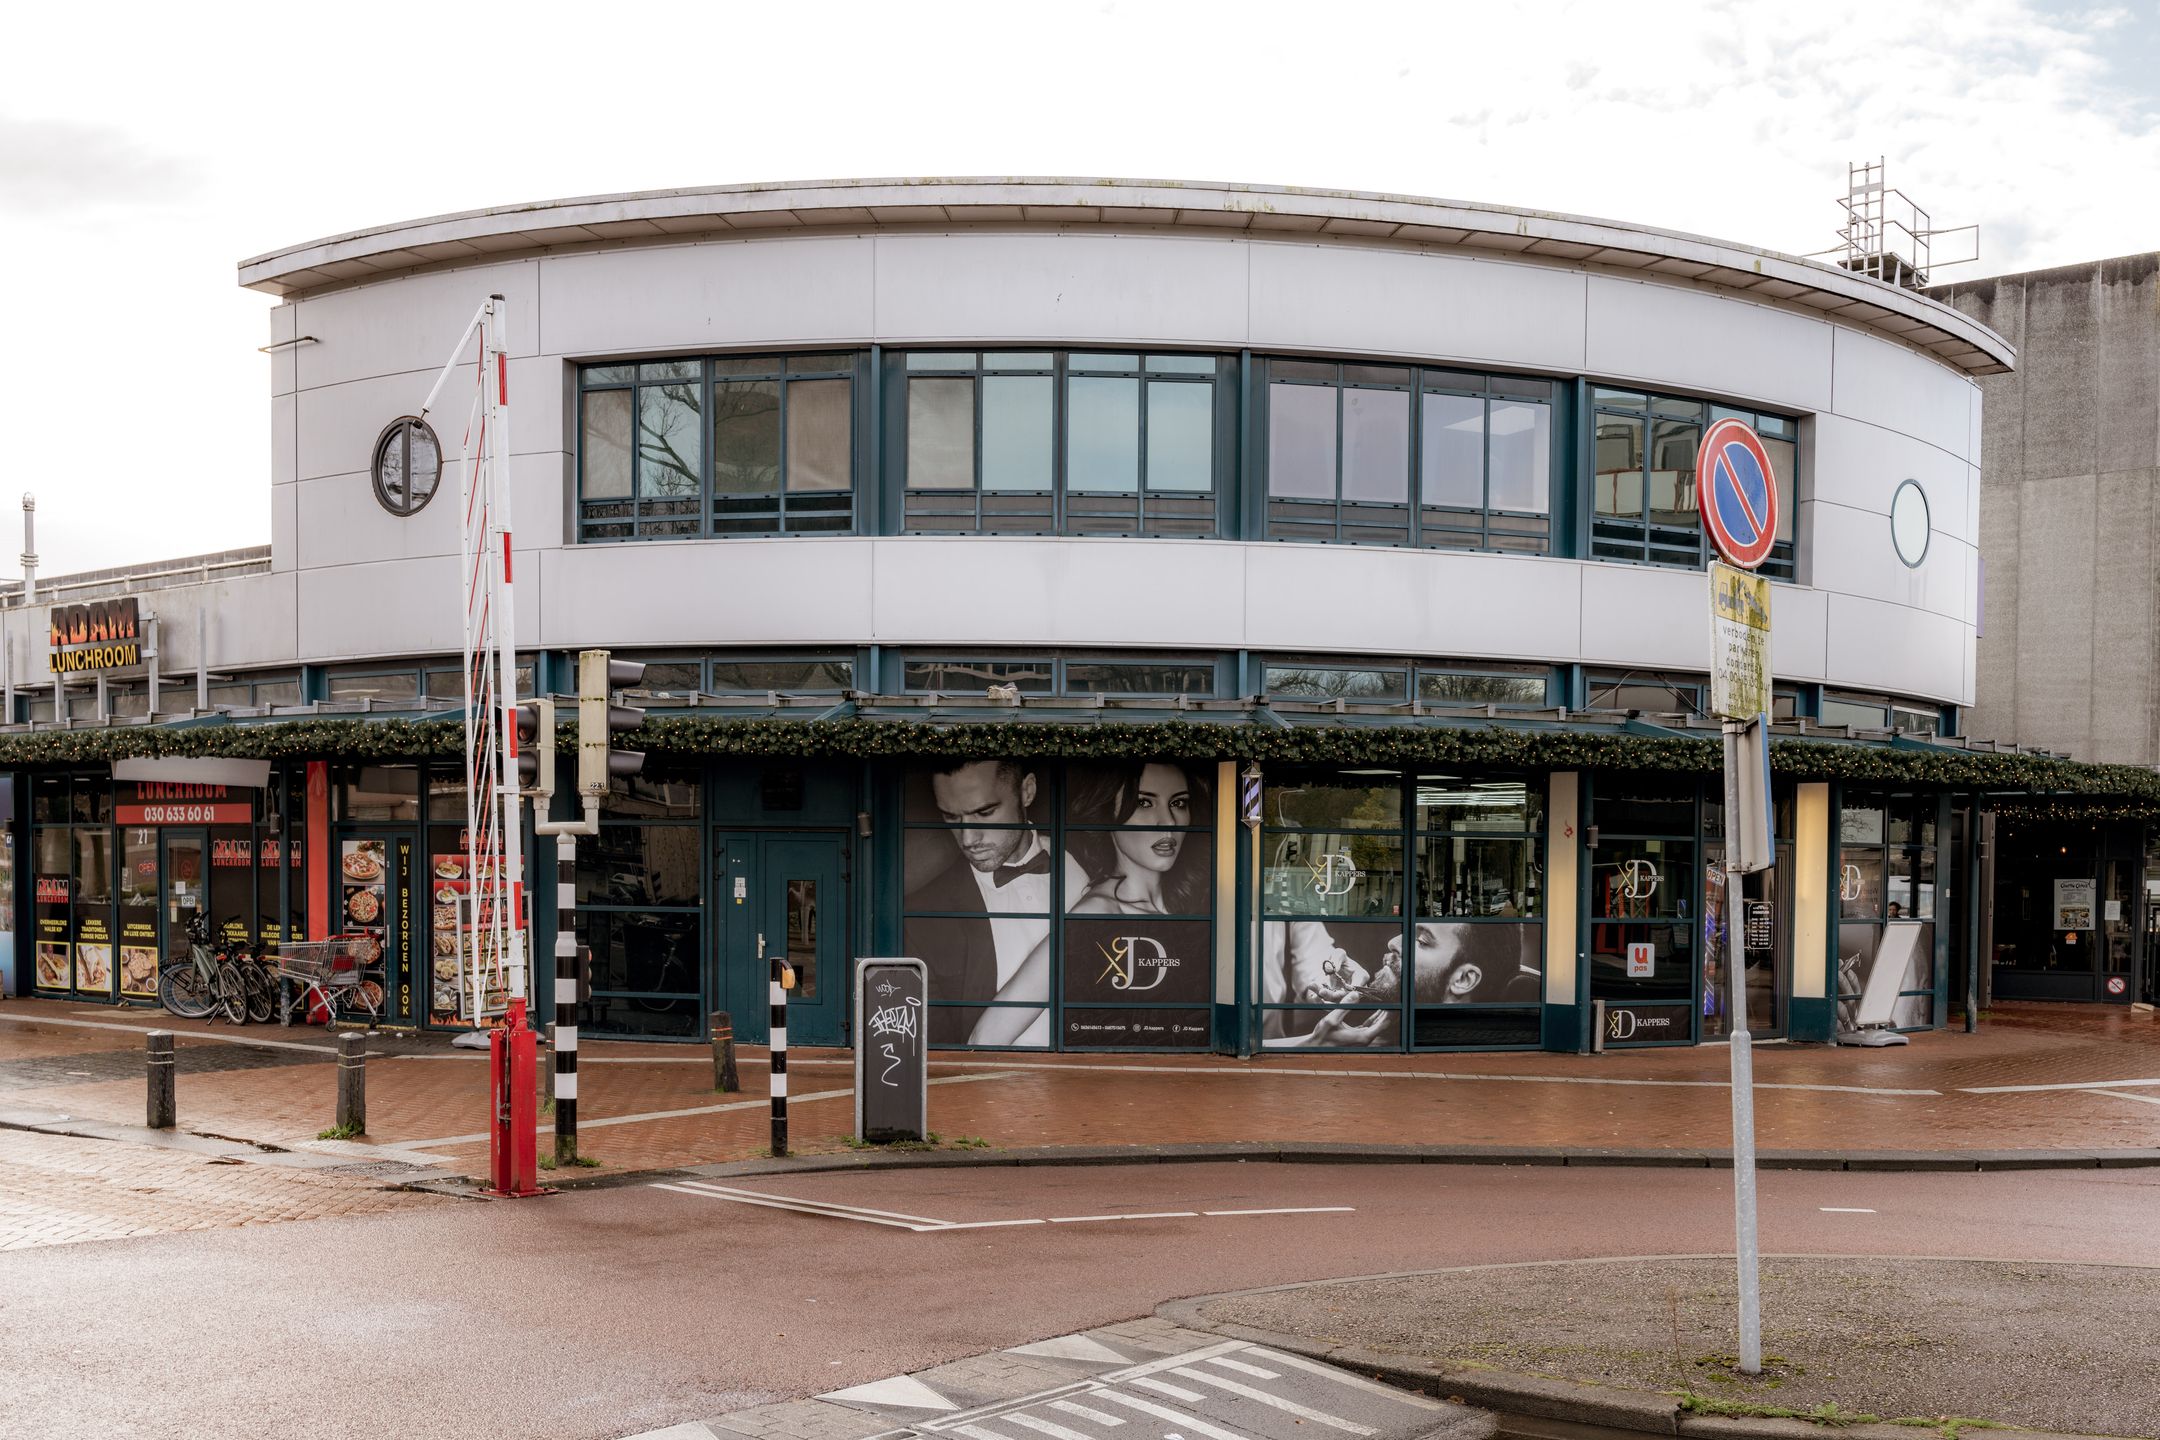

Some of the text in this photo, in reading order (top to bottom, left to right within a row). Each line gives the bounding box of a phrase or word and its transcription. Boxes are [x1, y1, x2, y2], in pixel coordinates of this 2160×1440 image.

[51, 598, 138, 646] ADAM
[50, 644, 137, 673] LUNCHROOM
[137, 782, 227, 799] LUNCHROOM
[144, 806, 214, 822] 030 633 60 61
[213, 858, 251, 866] LUNCHROOM
[400, 845, 410, 875] WIJ
[1707, 869, 1724, 886] OPEN
[1138, 958, 1181, 967] KAPPERS
[1634, 965, 1648, 973] pas
[1637, 1018, 1670, 1026] KAPPERS
